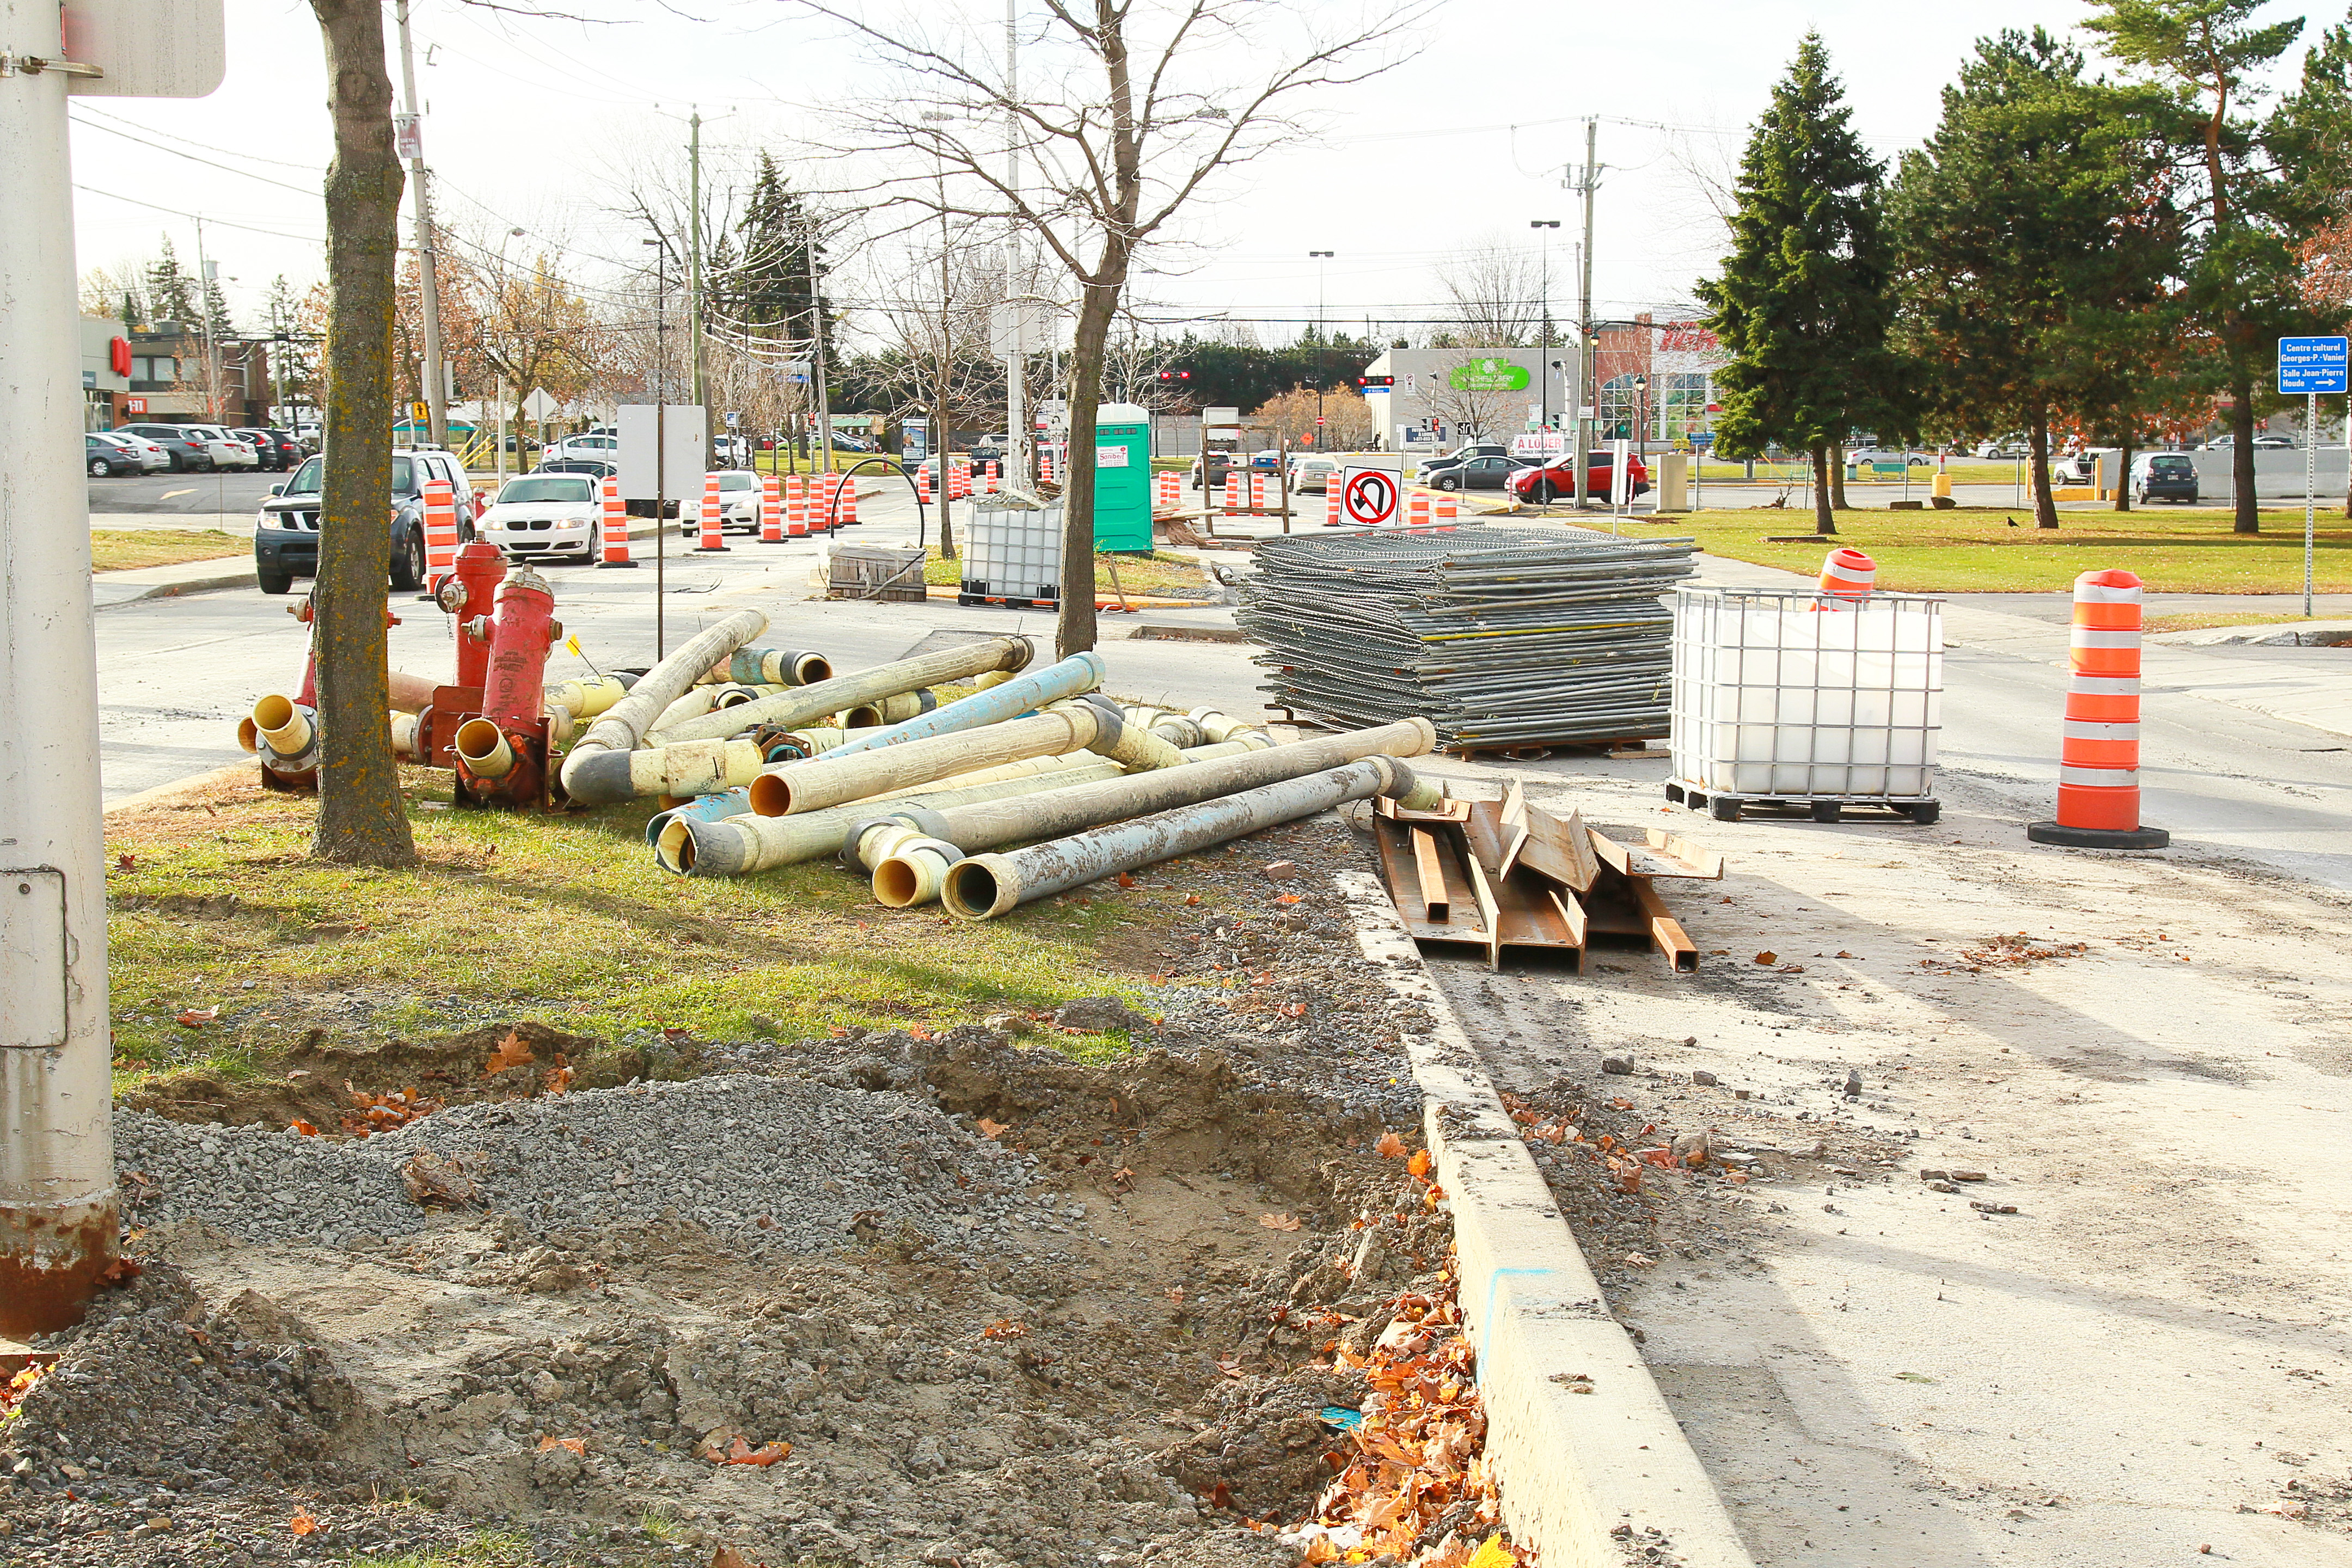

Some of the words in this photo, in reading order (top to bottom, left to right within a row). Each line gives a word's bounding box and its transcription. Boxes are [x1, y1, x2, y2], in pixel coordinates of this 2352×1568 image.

[2313, 343, 2341, 351] culturel
[2281, 353, 2345, 363] Georges-P.-Vanier
[2283, 379, 2305, 387] Houde
[1529, 438, 1561, 448] LOUER
